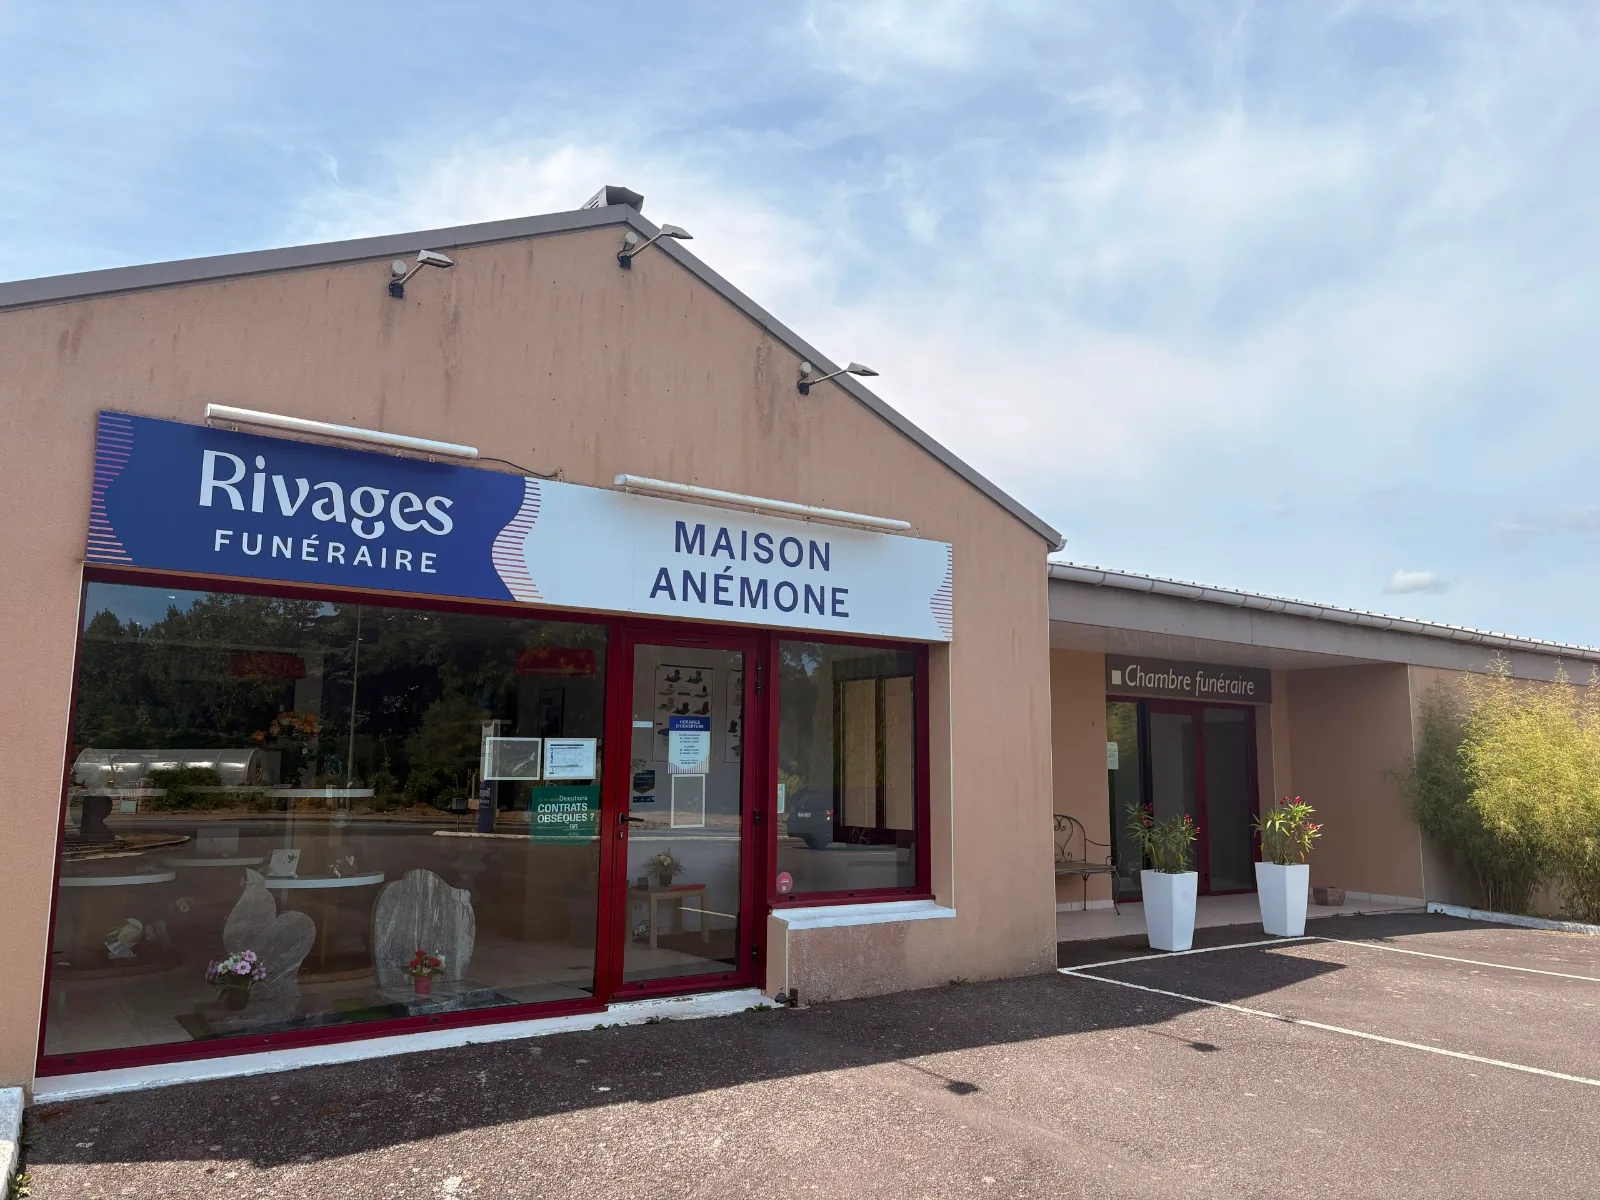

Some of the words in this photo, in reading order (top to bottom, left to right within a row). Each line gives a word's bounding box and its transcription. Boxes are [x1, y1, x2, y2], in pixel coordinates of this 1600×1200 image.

[199, 449, 454, 540] Rivages
[214, 529, 437, 574] FUNÉRAIRE
[675, 520, 830, 571] MAISON
[649, 565, 849, 618] ANÉMONE
[1125, 664, 1191, 690] Chambre
[1196, 671, 1254, 696] funéraire
[537, 803, 588, 813] CONTRATS
[537, 812, 588, 824] OBSÈQUES
[590, 812, 595, 821] ?
